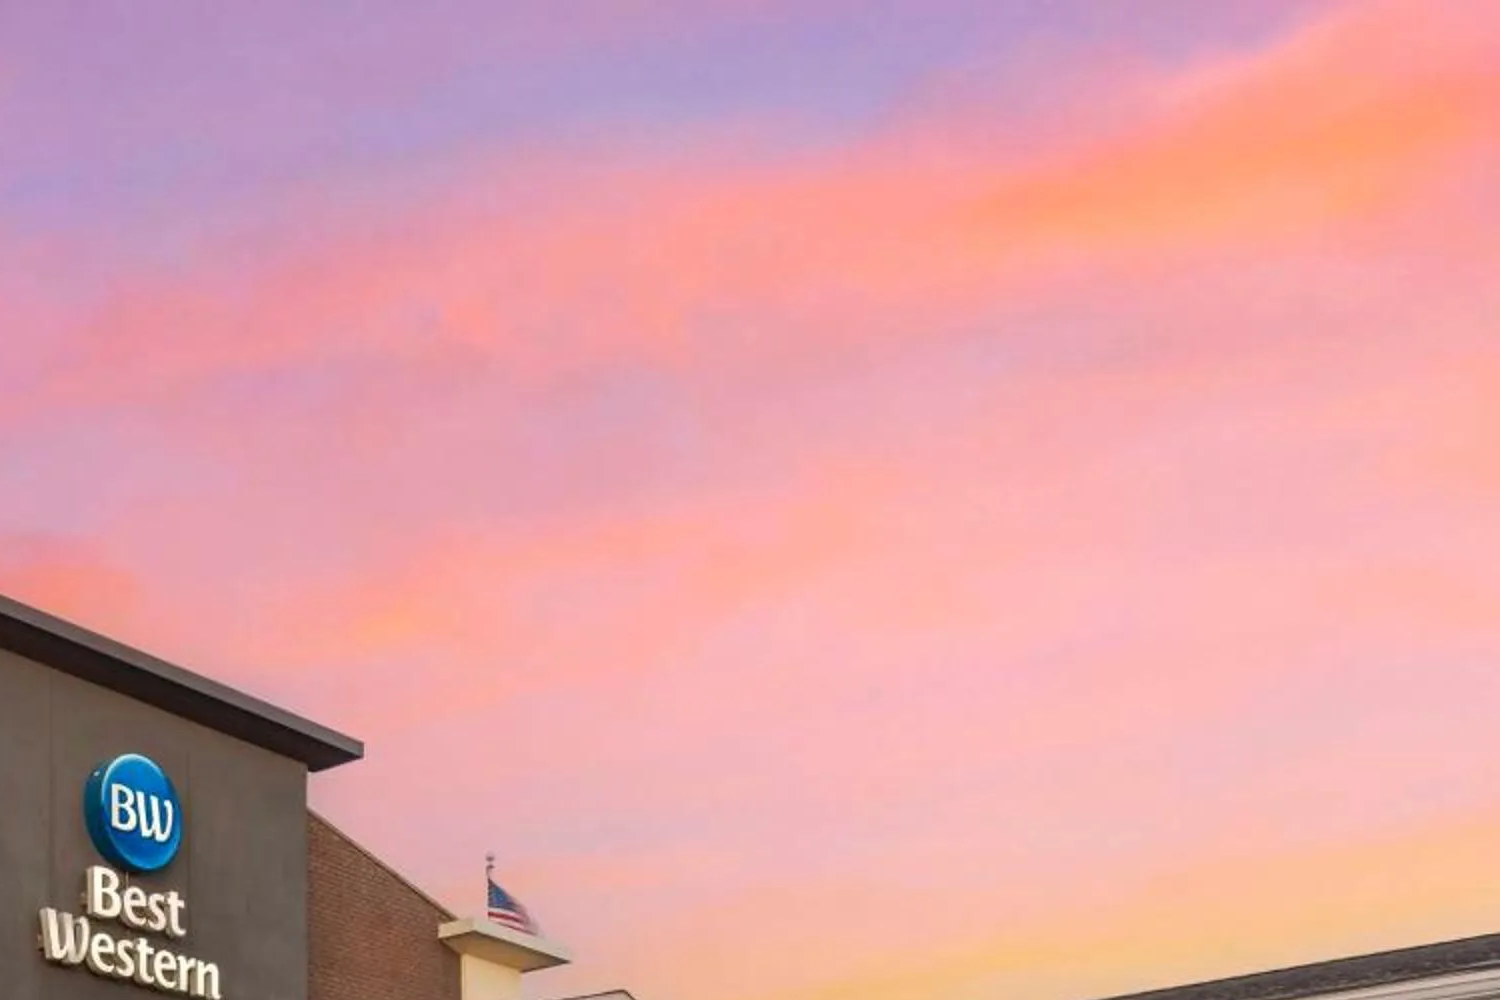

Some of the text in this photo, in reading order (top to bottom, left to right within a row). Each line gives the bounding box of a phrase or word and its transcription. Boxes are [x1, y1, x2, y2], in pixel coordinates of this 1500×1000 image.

[111, 783, 173, 842] BW
[87, 865, 186, 936] Best
[40, 907, 221, 1000] Western
